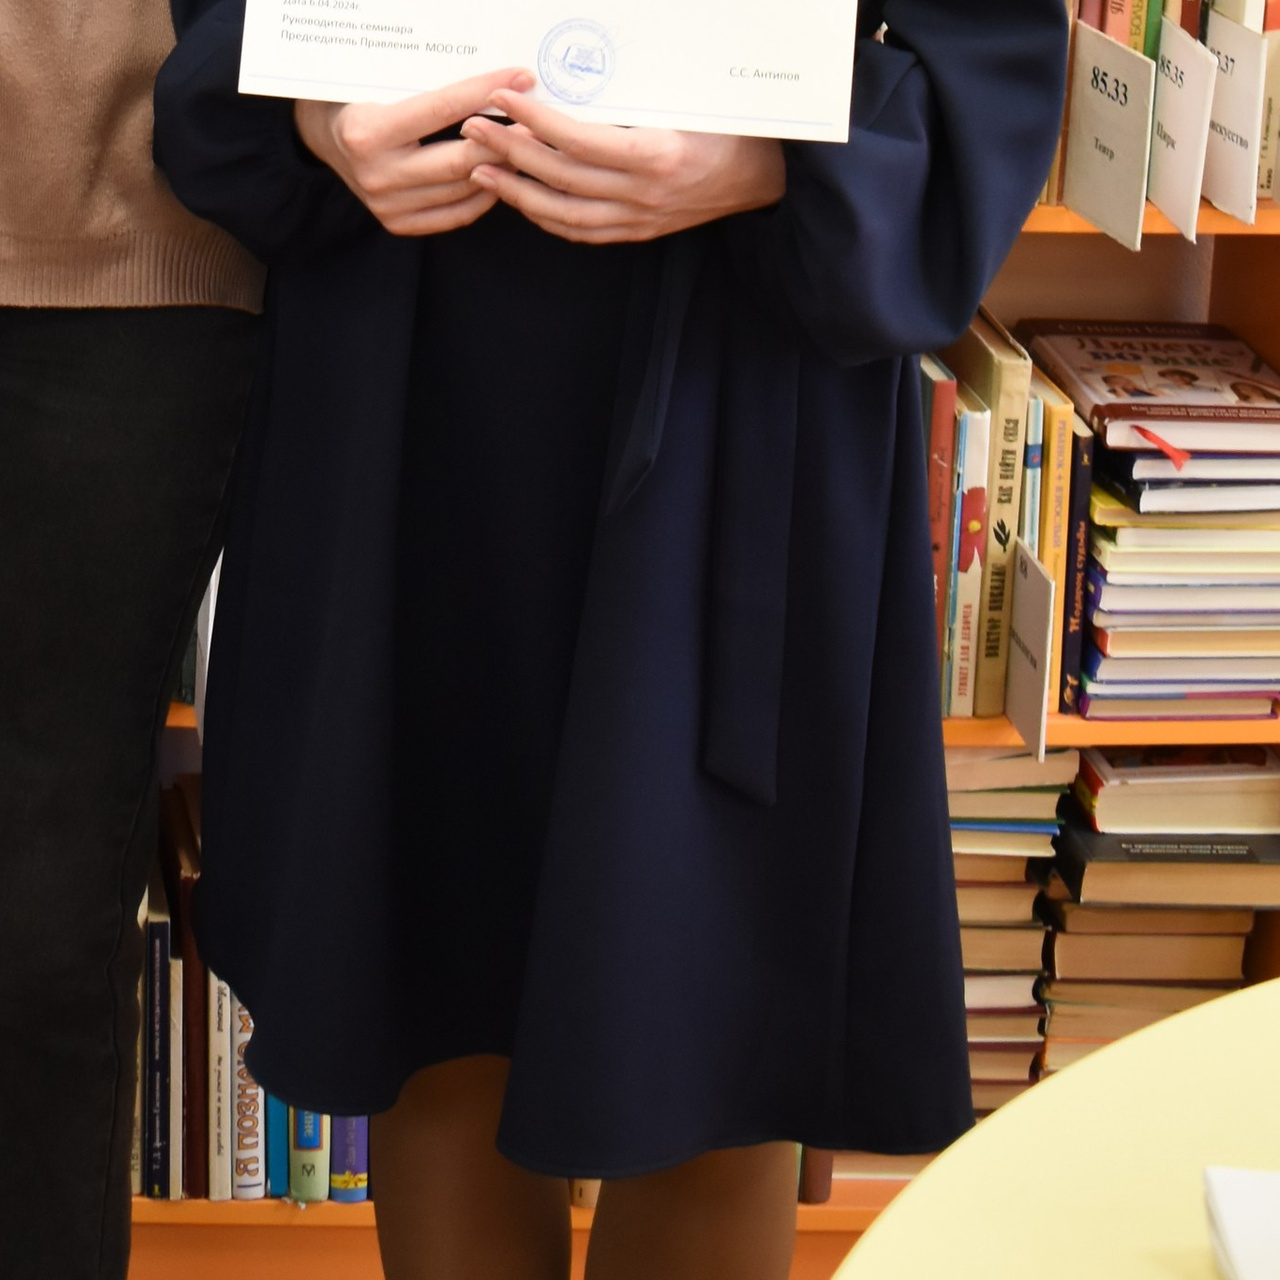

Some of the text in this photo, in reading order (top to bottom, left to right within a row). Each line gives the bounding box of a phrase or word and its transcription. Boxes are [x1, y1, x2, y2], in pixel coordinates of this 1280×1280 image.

[282, 14, 413, 35] Руководитель семинара
[281, 30, 477, 55] Председатель Правления МОО СПР
[754, 69, 800, 81] Антипов
[1159, 54, 1185, 89] 85.35
[1090, 66, 1129, 106] 85.33
